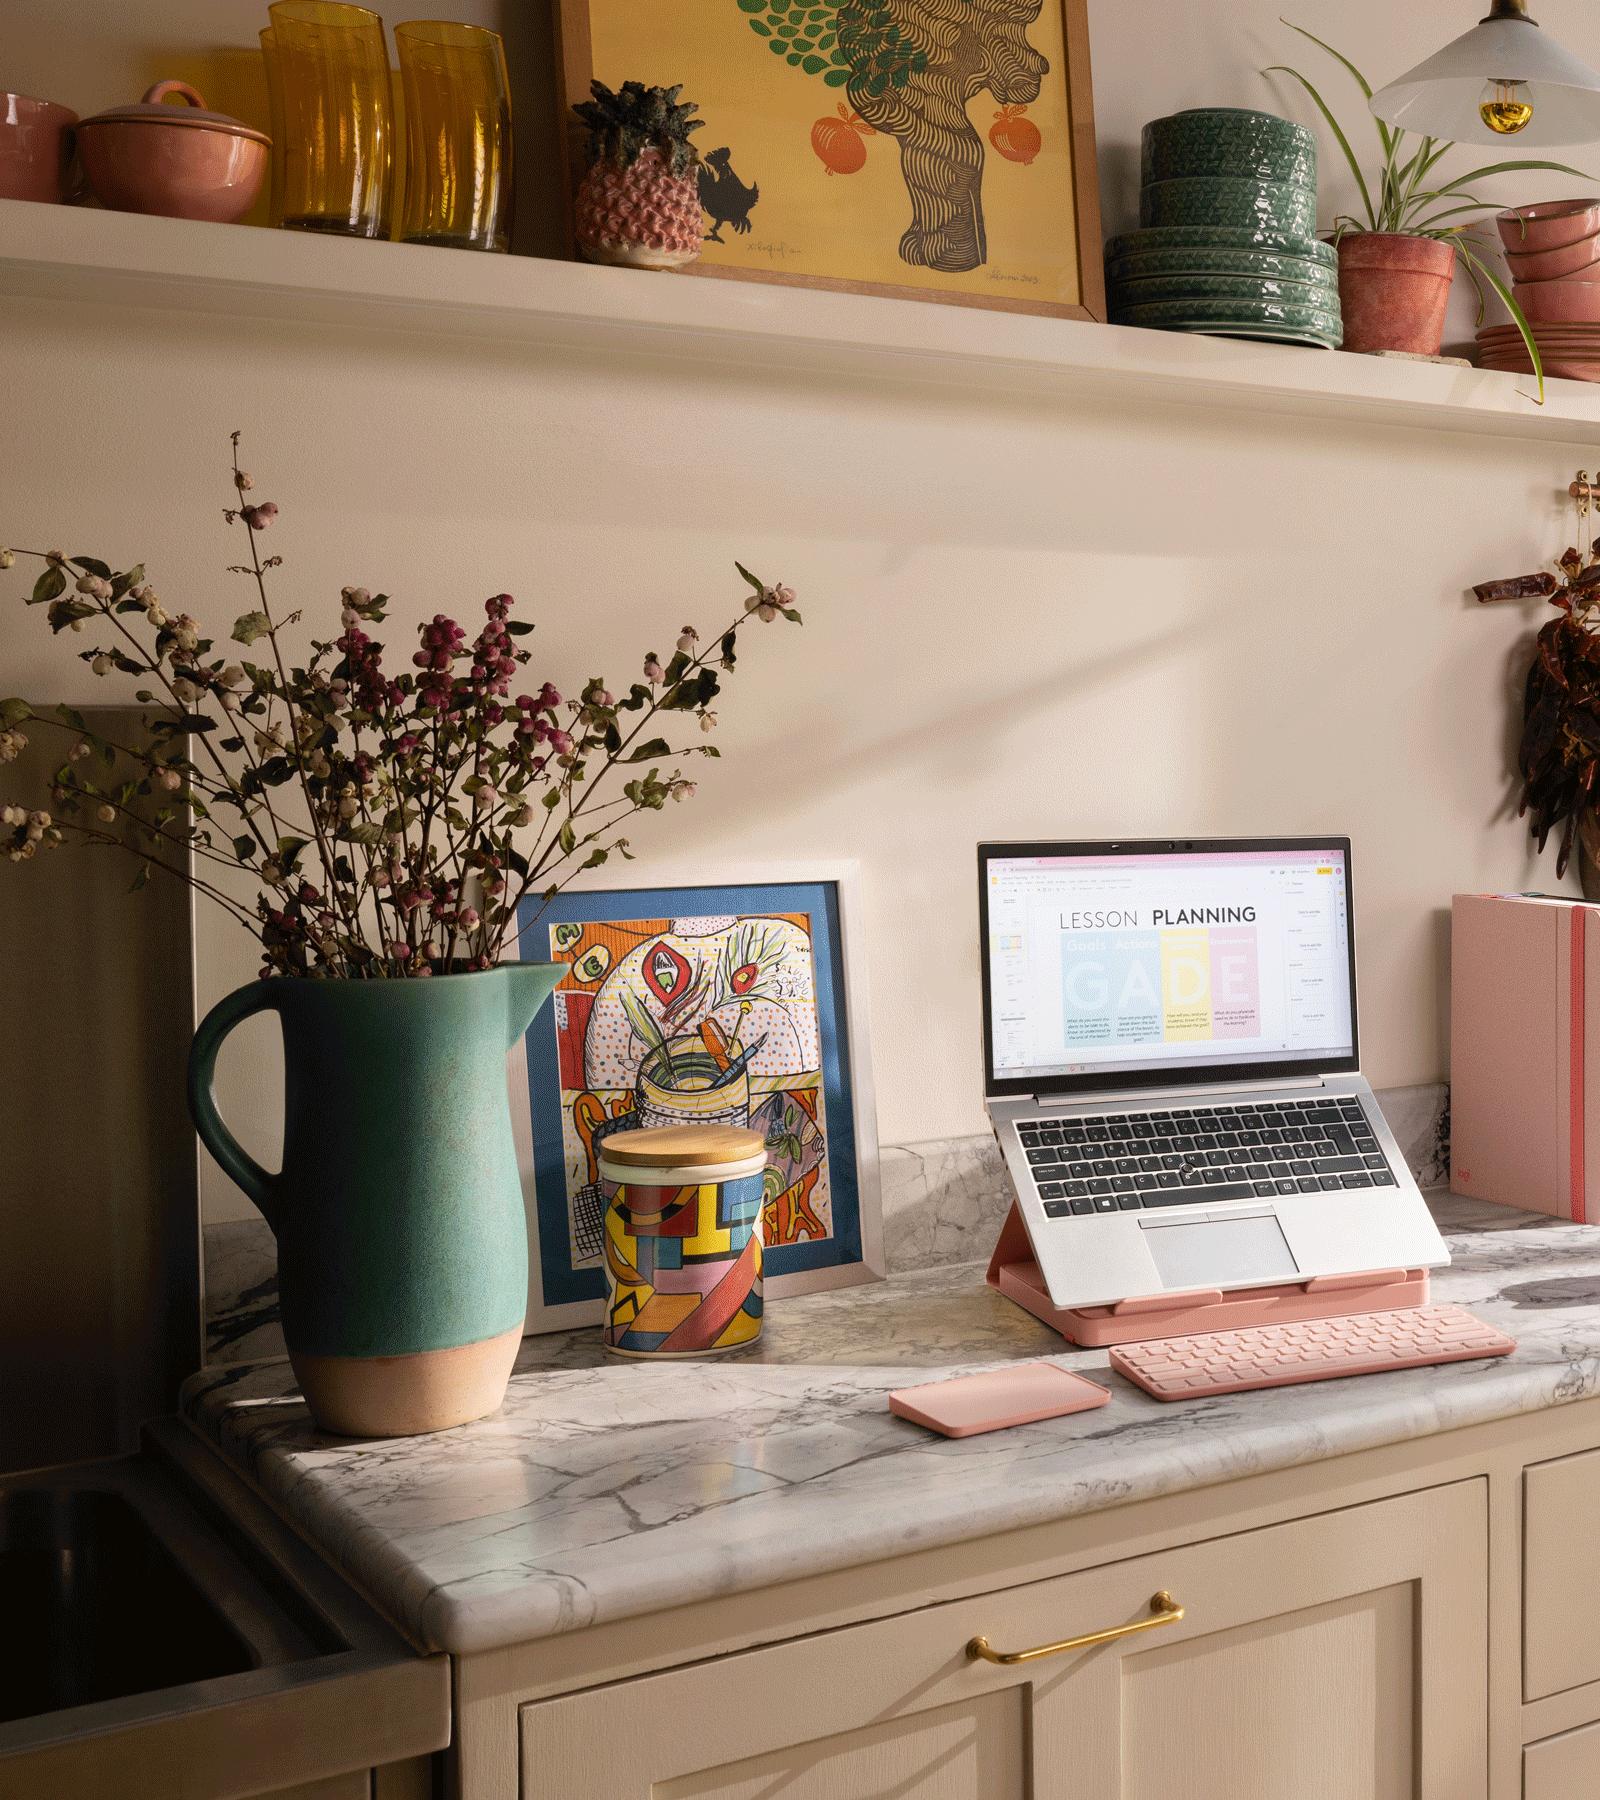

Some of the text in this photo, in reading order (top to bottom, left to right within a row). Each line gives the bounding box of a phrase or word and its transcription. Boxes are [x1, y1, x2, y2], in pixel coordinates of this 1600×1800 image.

[1060, 907, 1256, 929] LESSON PLANNING
[1068, 939, 1106, 951] Goals
[1116, 938, 1158, 950] Actions
[1066, 956, 1249, 1010] G A D E
[1458, 1168, 1470, 1182] logi
